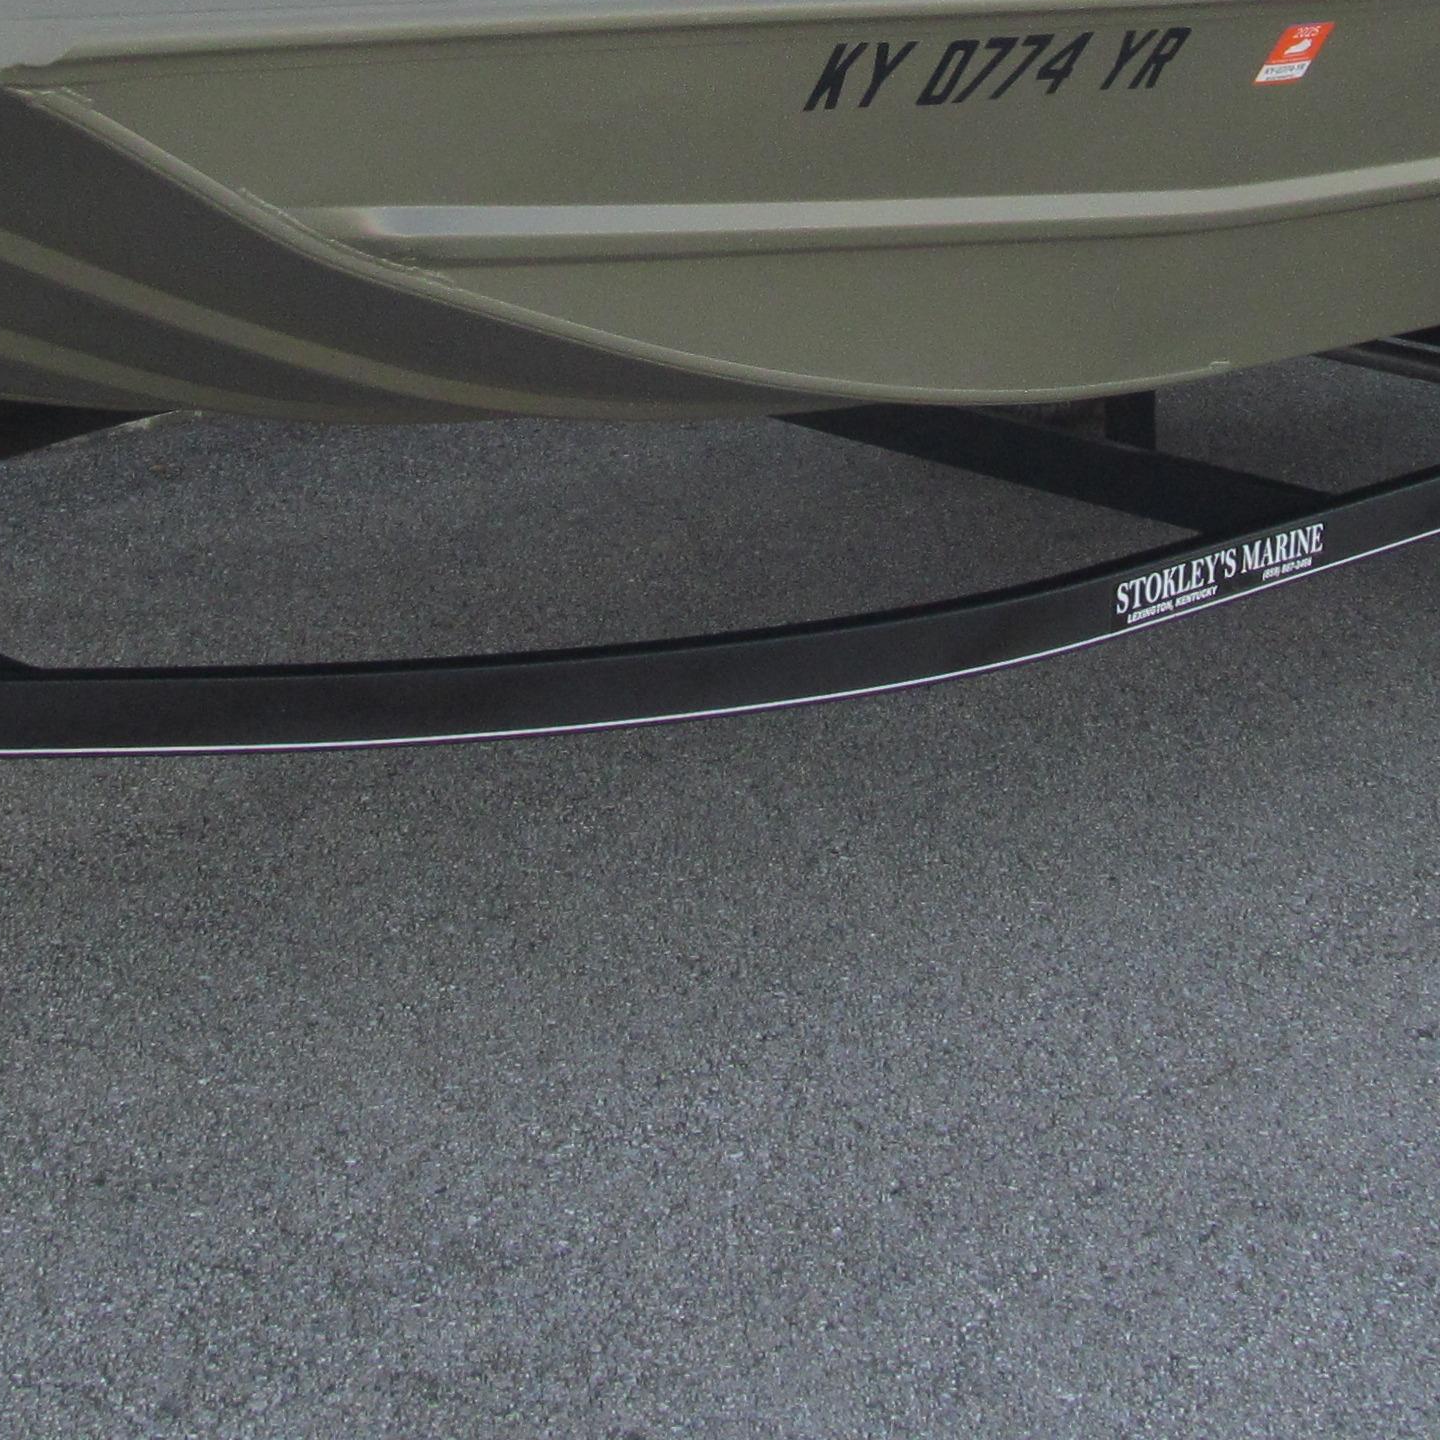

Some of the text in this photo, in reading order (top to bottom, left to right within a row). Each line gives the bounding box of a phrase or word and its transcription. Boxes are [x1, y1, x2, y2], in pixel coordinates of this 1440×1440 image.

[803, 27, 1192, 112] KY 0774 YR
[1116, 523, 1324, 615] STOKLEY'S MARINE
[1175, 585, 1218, 608] KENTUCKY
